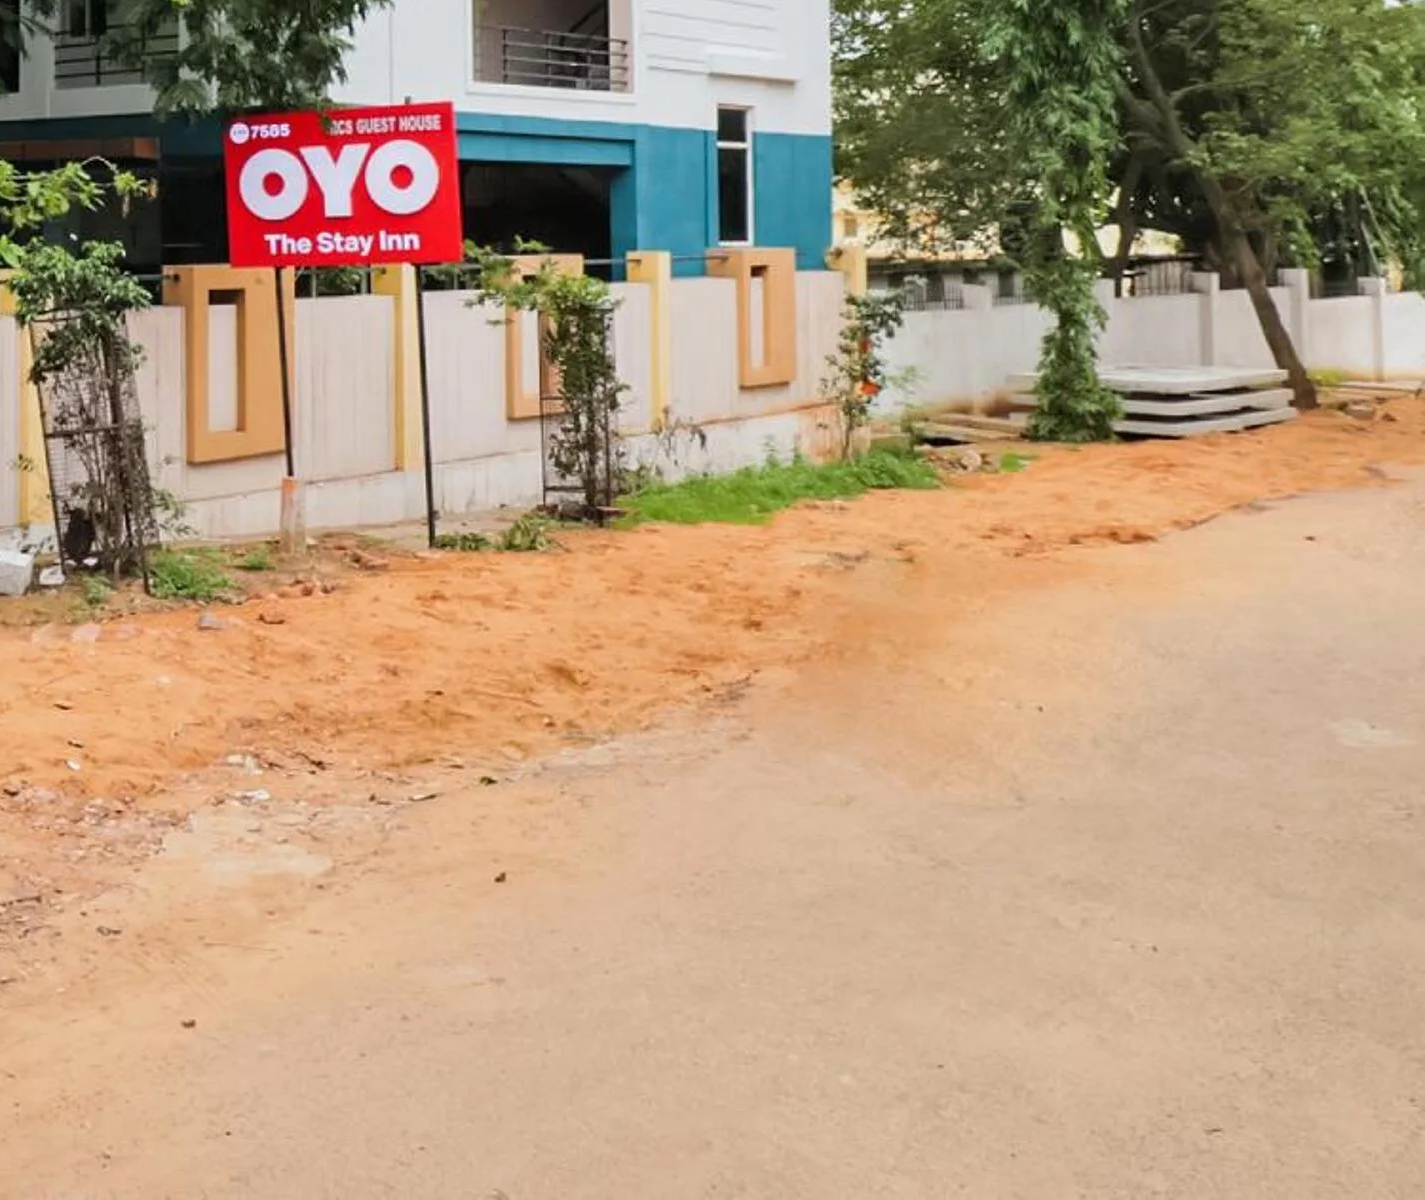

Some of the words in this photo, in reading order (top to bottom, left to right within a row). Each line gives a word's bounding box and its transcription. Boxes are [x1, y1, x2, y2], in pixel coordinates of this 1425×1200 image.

[356, 116, 396, 134] GUEST
[398, 114, 442, 131] HOUSE
[239, 139, 440, 221] OYO
[263, 234, 312, 255] The
[316, 232, 374, 256] Stay
[379, 230, 421, 251] Inn
